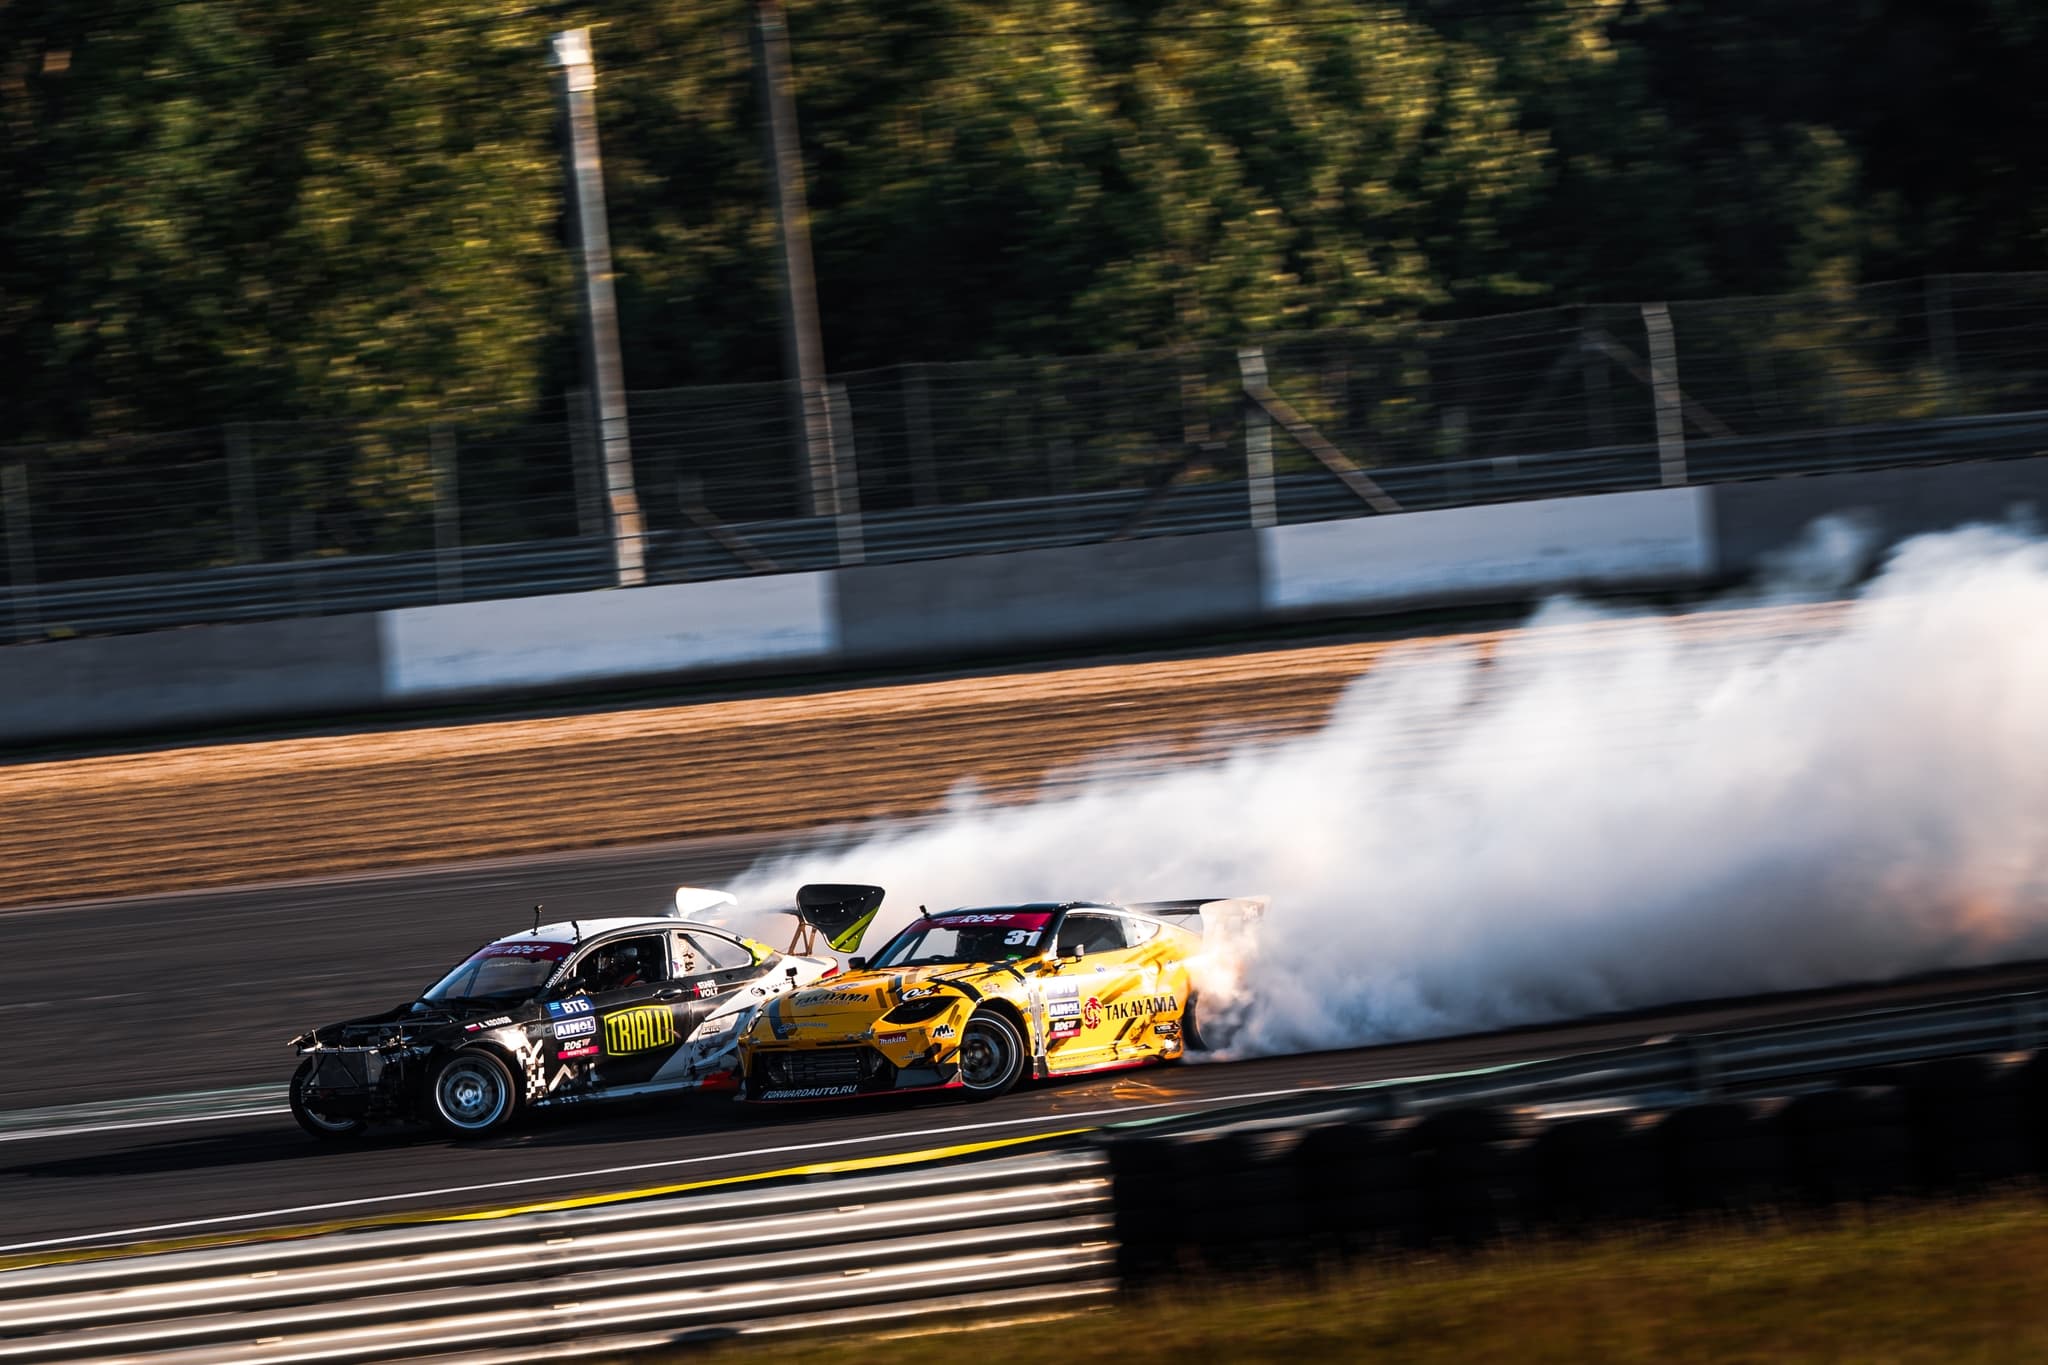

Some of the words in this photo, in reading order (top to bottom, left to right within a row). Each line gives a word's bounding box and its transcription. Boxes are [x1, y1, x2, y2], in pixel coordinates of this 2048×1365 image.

[1004, 930, 1042, 947] 31
[700, 987, 719, 998] VOLT
[561, 999, 590, 1014] ВТБ
[1105, 995, 1178, 1020] TAKAYAMA
[557, 1019, 594, 1036] AIMOL
[608, 1010, 670, 1052] TRIALLI
[880, 1035, 907, 1045] makita
[763, 1084, 858, 1099] FORWARDAUTO.RU
